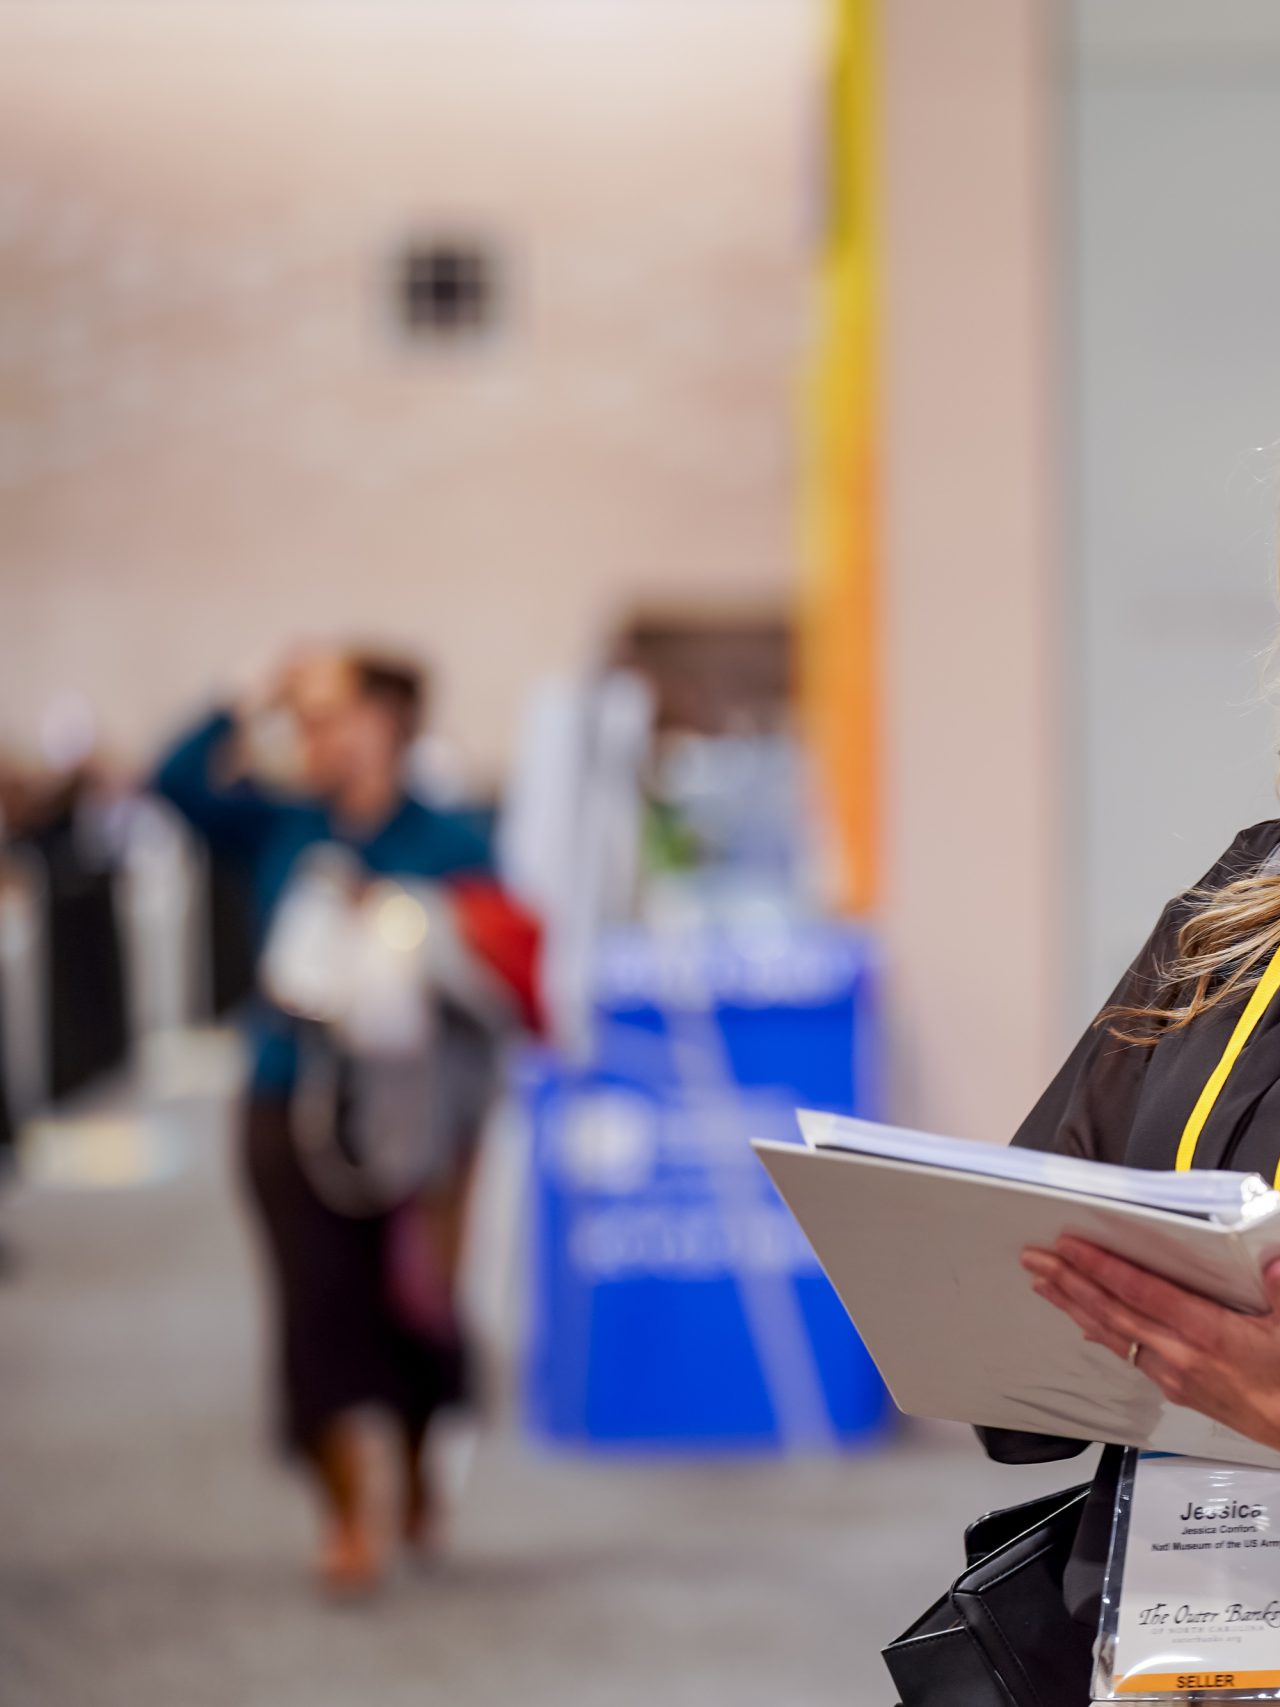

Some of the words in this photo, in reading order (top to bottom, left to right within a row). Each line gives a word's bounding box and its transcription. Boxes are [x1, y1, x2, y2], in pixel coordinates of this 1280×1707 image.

[1181, 1526, 1217, 1535] Jessica
[1173, 1541, 1212, 1550] Museum
[1215, 1541, 1224, 1549] of
[1226, 1540, 1241, 1549] the
[1244, 1539, 1258, 1548] US
[1139, 1603, 1170, 1625] The
[1175, 1604, 1219, 1624] Outer
[1176, 1675, 1235, 1688] SELLER
